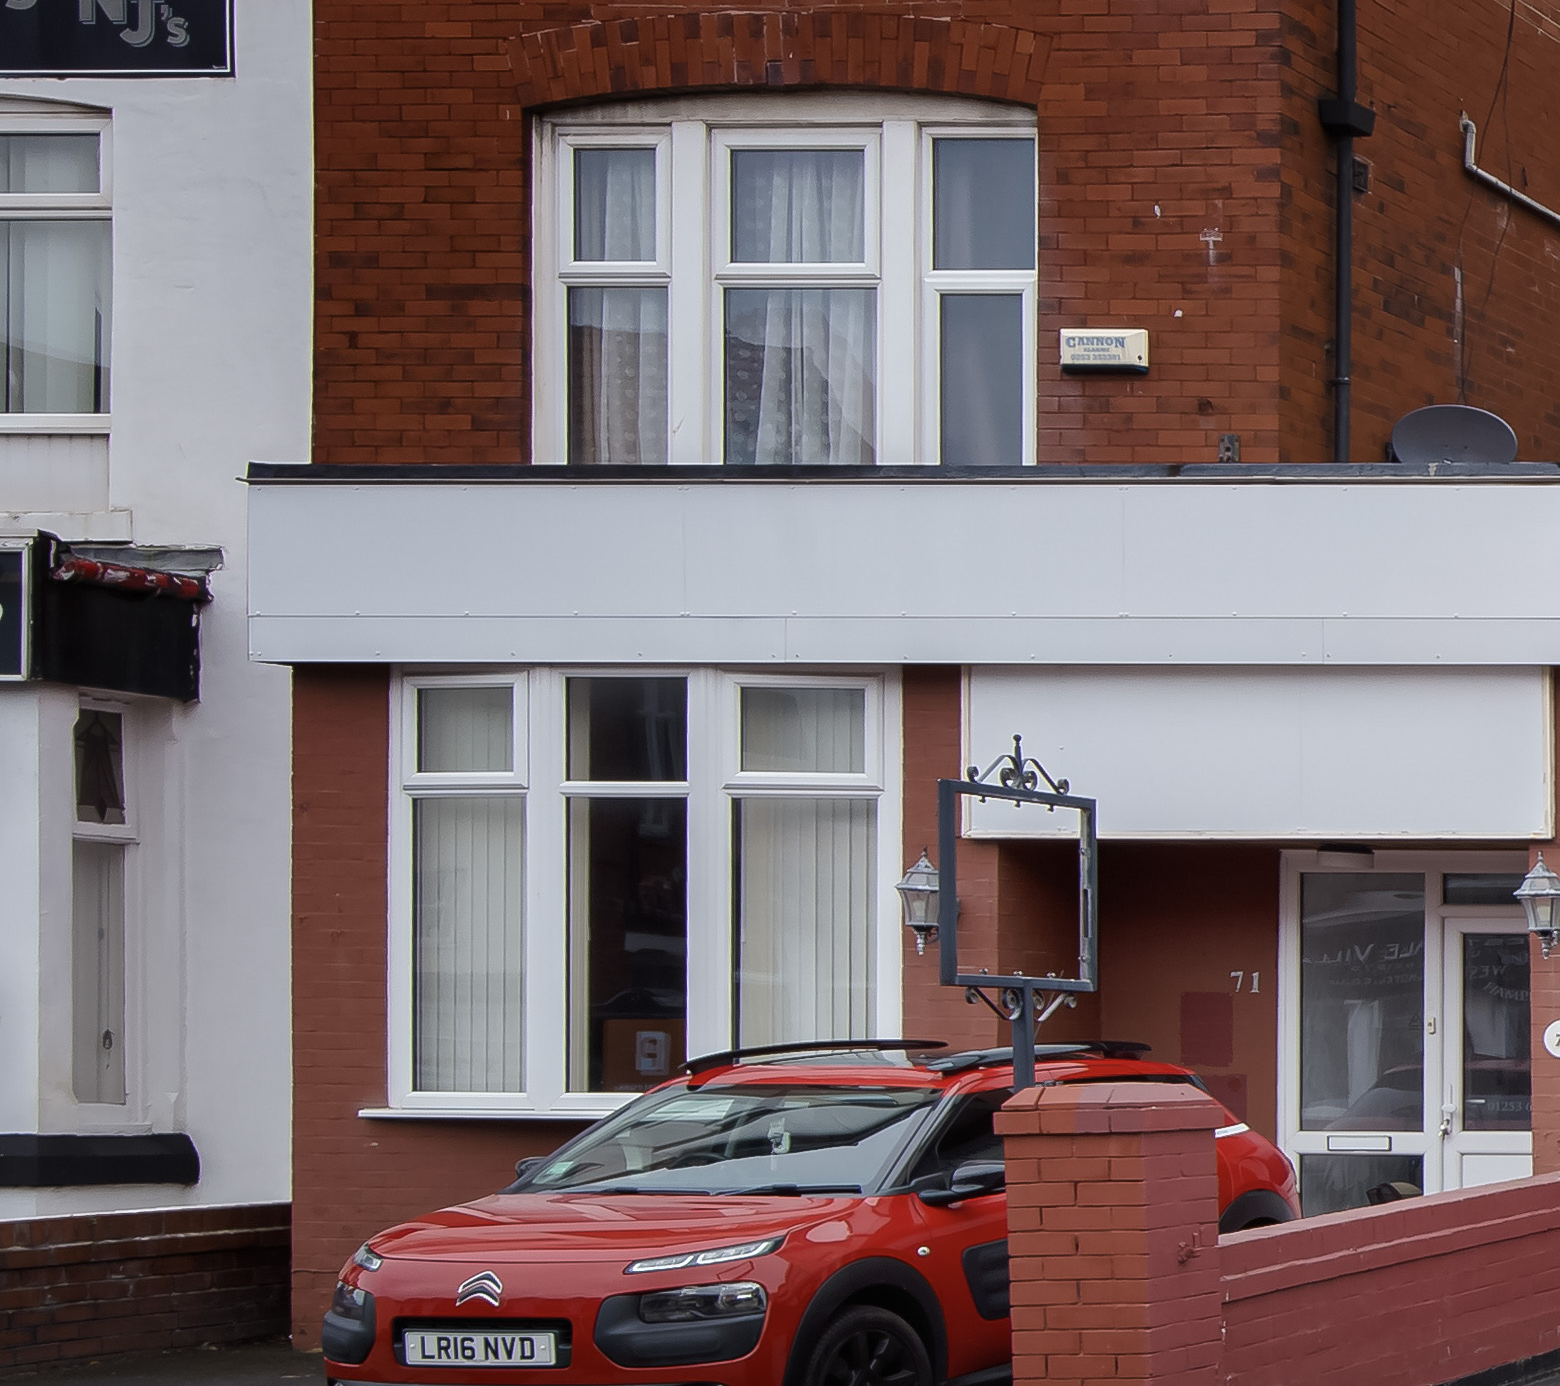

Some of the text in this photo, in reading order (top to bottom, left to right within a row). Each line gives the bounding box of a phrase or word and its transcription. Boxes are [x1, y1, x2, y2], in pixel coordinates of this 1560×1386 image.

[1065, 336, 1126, 348] CANNON
[1230, 971, 1260, 993] 71
[420, 1336, 536, 1361] LR16 NVD
